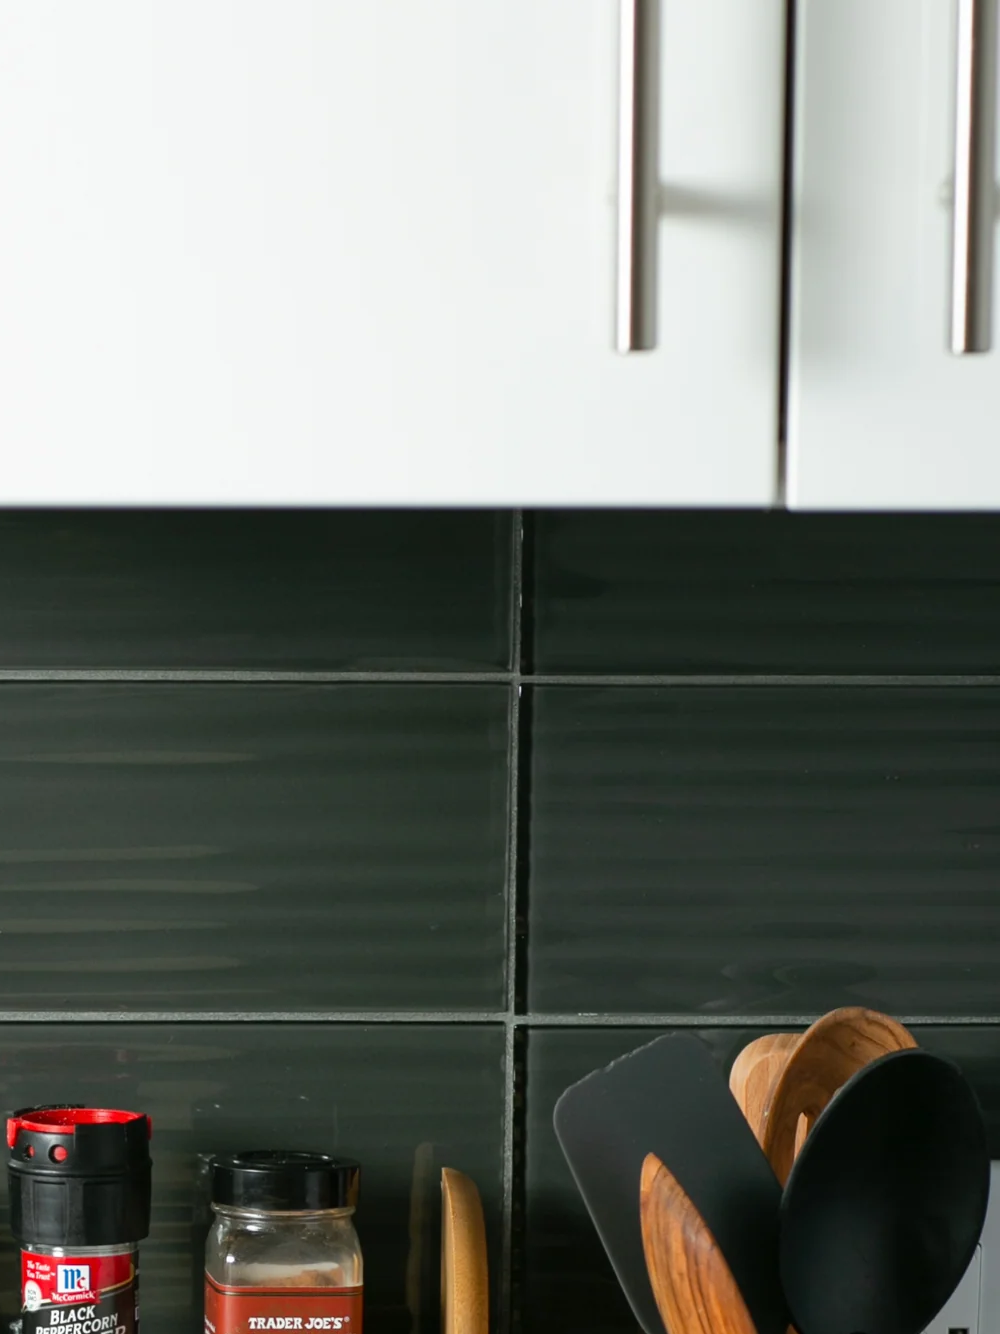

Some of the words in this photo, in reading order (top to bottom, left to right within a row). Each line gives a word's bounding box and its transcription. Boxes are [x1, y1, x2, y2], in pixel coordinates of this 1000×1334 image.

[51, 1290, 95, 1302] McCormick
[50, 1305, 96, 1325] BLACK
[248, 1317, 303, 1329] TRADER
[304, 1317, 343, 1329] JOE'S
